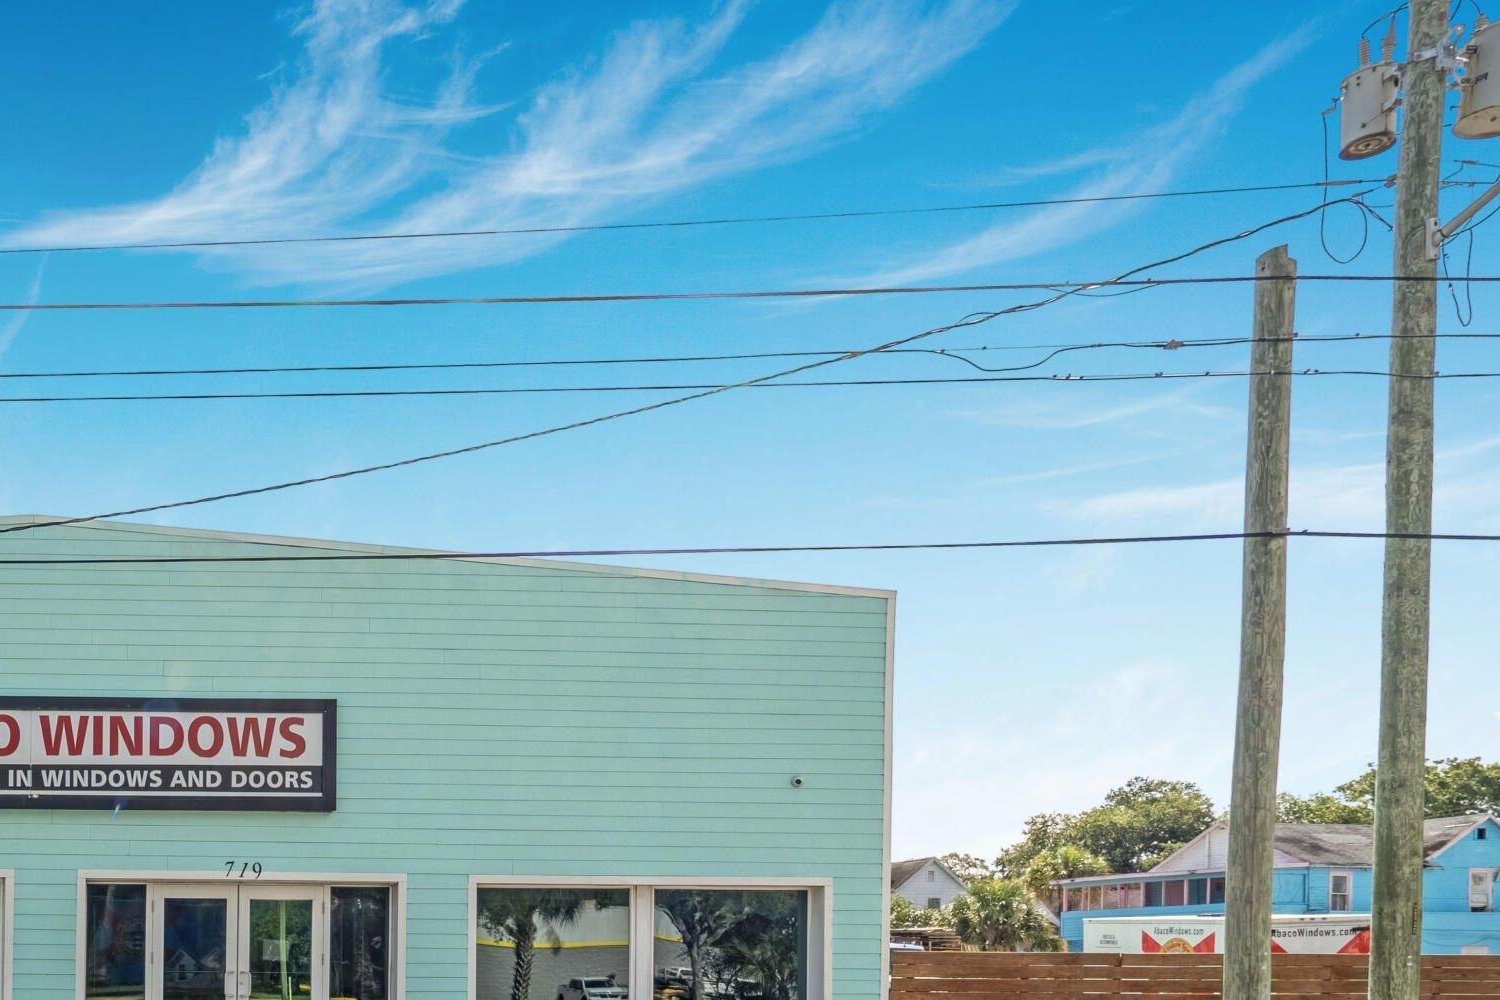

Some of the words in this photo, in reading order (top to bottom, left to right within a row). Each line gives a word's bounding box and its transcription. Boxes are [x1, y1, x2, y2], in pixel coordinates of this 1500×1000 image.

[39, 714, 306, 759] WINDOWS
[8, 769, 33, 787] IN
[41, 769, 163, 788] WINDOWS
[170, 770, 222, 788] AND
[231, 770, 313, 789] DOORS
[225, 861, 262, 880] 719
